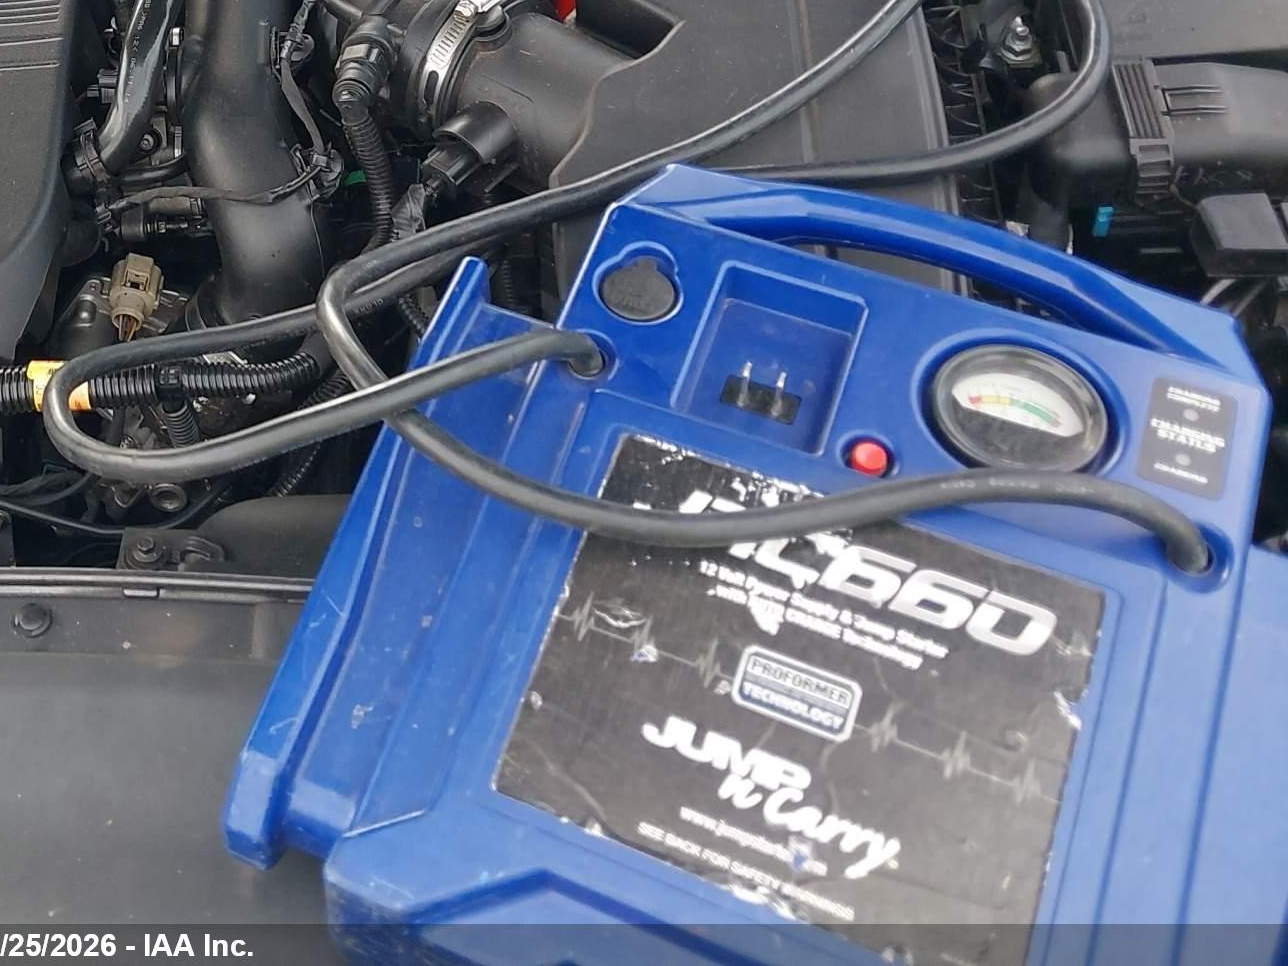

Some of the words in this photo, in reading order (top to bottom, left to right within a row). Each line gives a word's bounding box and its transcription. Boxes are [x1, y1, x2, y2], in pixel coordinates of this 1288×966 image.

[1151, 418, 1225, 447] CHARGING
[1157, 428, 1217, 453] STATUS
[699, 560, 718, 577] 12
[718, 565, 746, 587] Volt
[745, 575, 791, 602] Power
[790, 592, 840, 621] Supply
[839, 609, 853, 626] &
[853, 614, 896, 641] Jump
[895, 628, 949, 659] Starter
[841, 627, 923, 670] Technology
[741, 682, 844, 730] TECHNOLOGY
[751, 655, 852, 709] PROFORMER
[642, 715, 811, 791] JUMP
[637, 821, 664, 842] SEE
[664, 833, 702, 857] BACK
[701, 847, 731, 870] FOR
[730, 861, 781, 890] SAFETY
[763, 787, 900, 878] Carry
